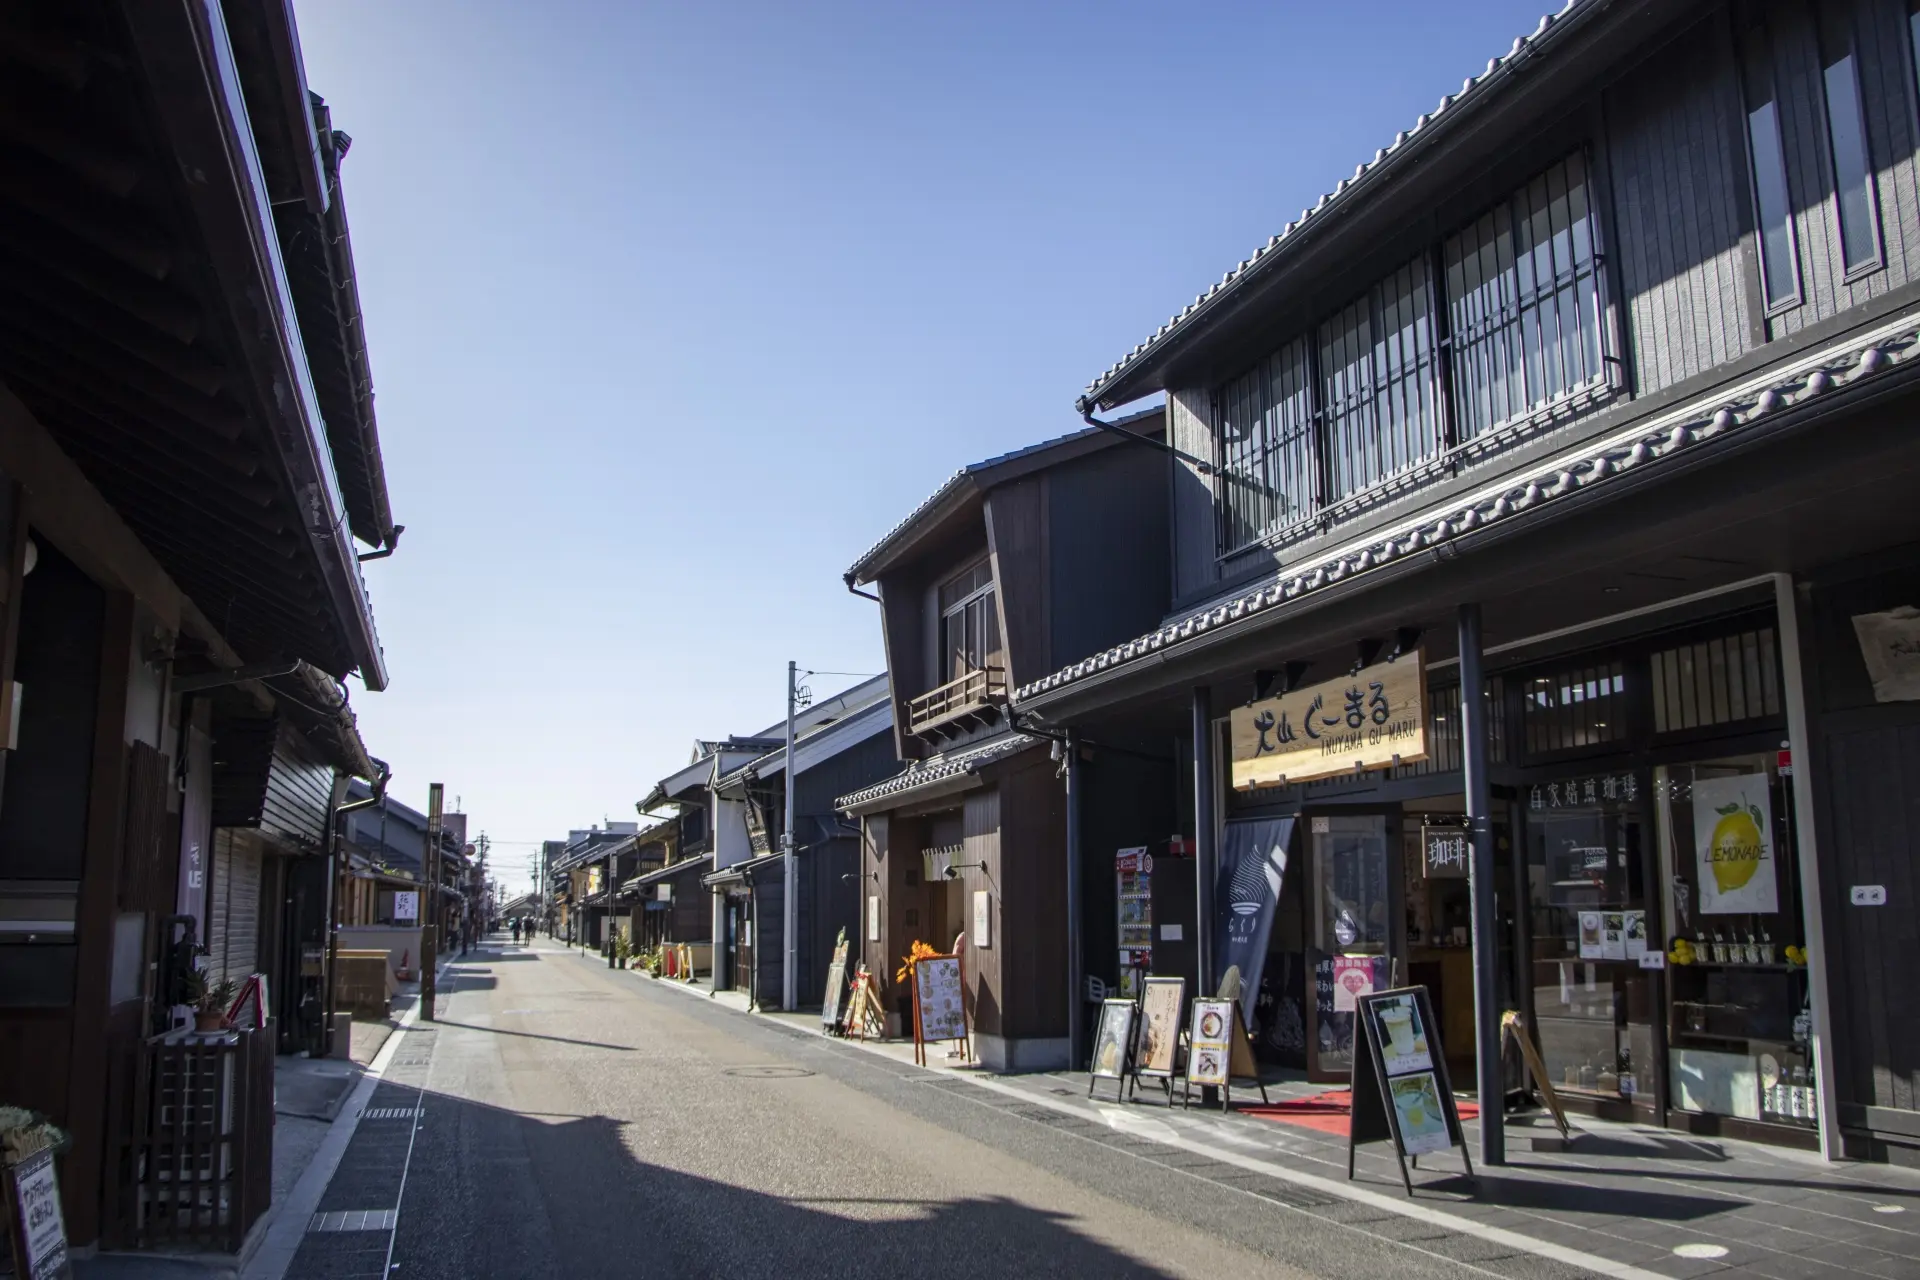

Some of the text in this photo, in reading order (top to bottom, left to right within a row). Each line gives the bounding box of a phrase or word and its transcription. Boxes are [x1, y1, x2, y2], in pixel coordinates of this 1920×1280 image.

[1321, 718, 1416, 757] INUYAMA GU MARU
[1427, 837, 1466, 870] 珈琲
[1704, 844, 1770, 863] LEMONADE
